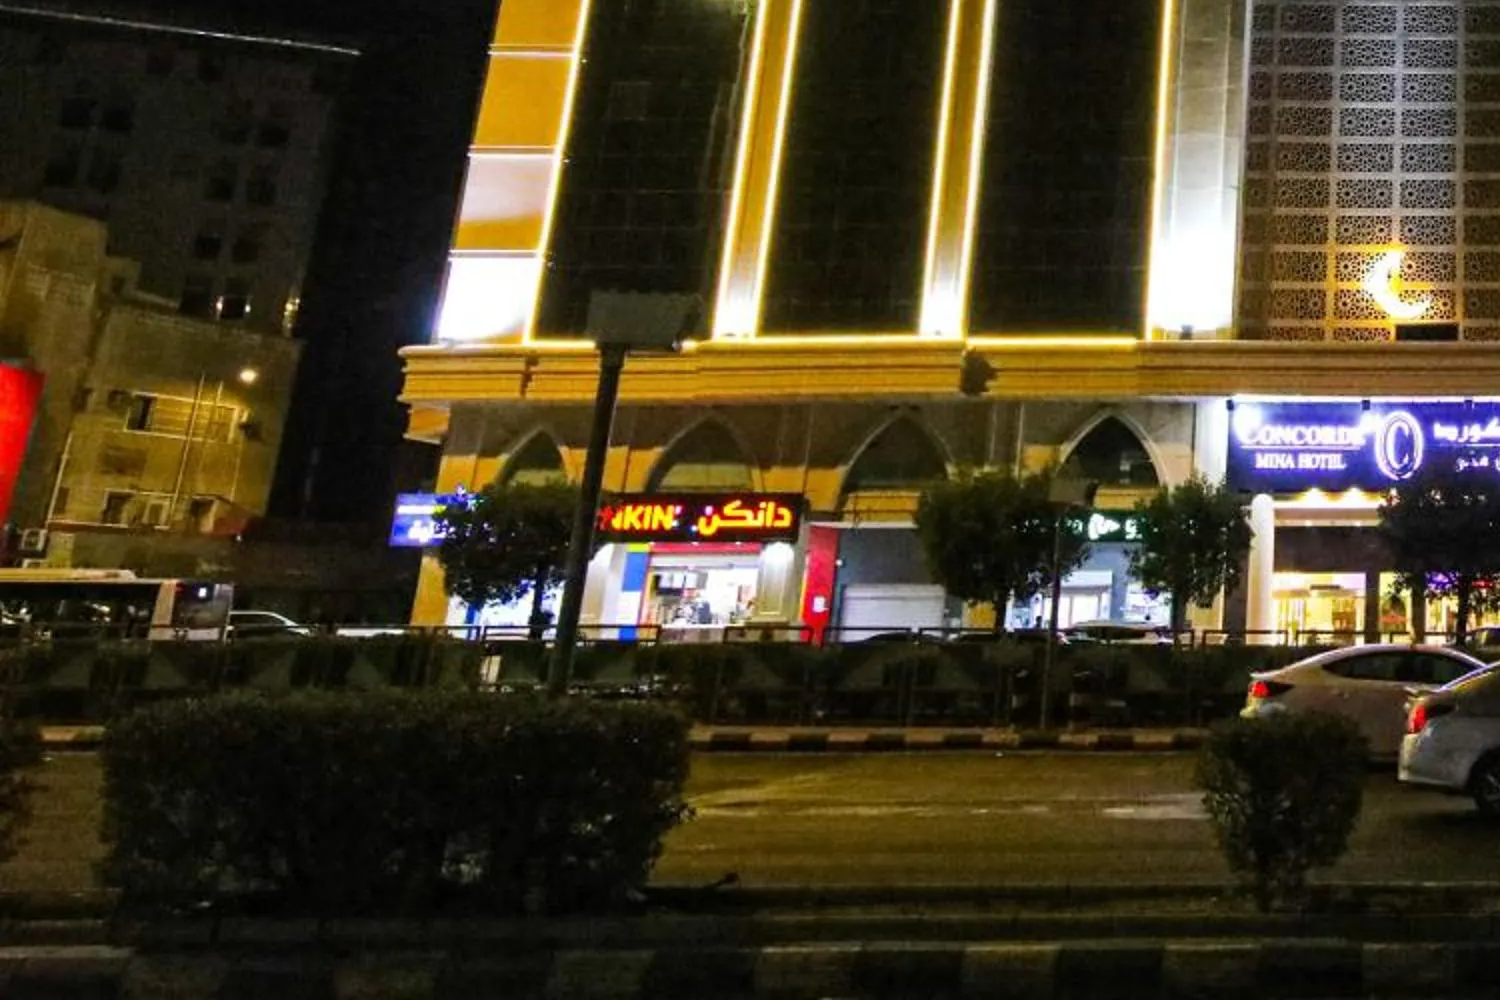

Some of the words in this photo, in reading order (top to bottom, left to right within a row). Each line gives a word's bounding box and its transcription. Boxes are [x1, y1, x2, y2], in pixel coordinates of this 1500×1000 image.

[1255, 453, 1295, 469] MINA
[1298, 453, 1347, 470] HOTEL
[698, 500, 792, 536] دانكن
